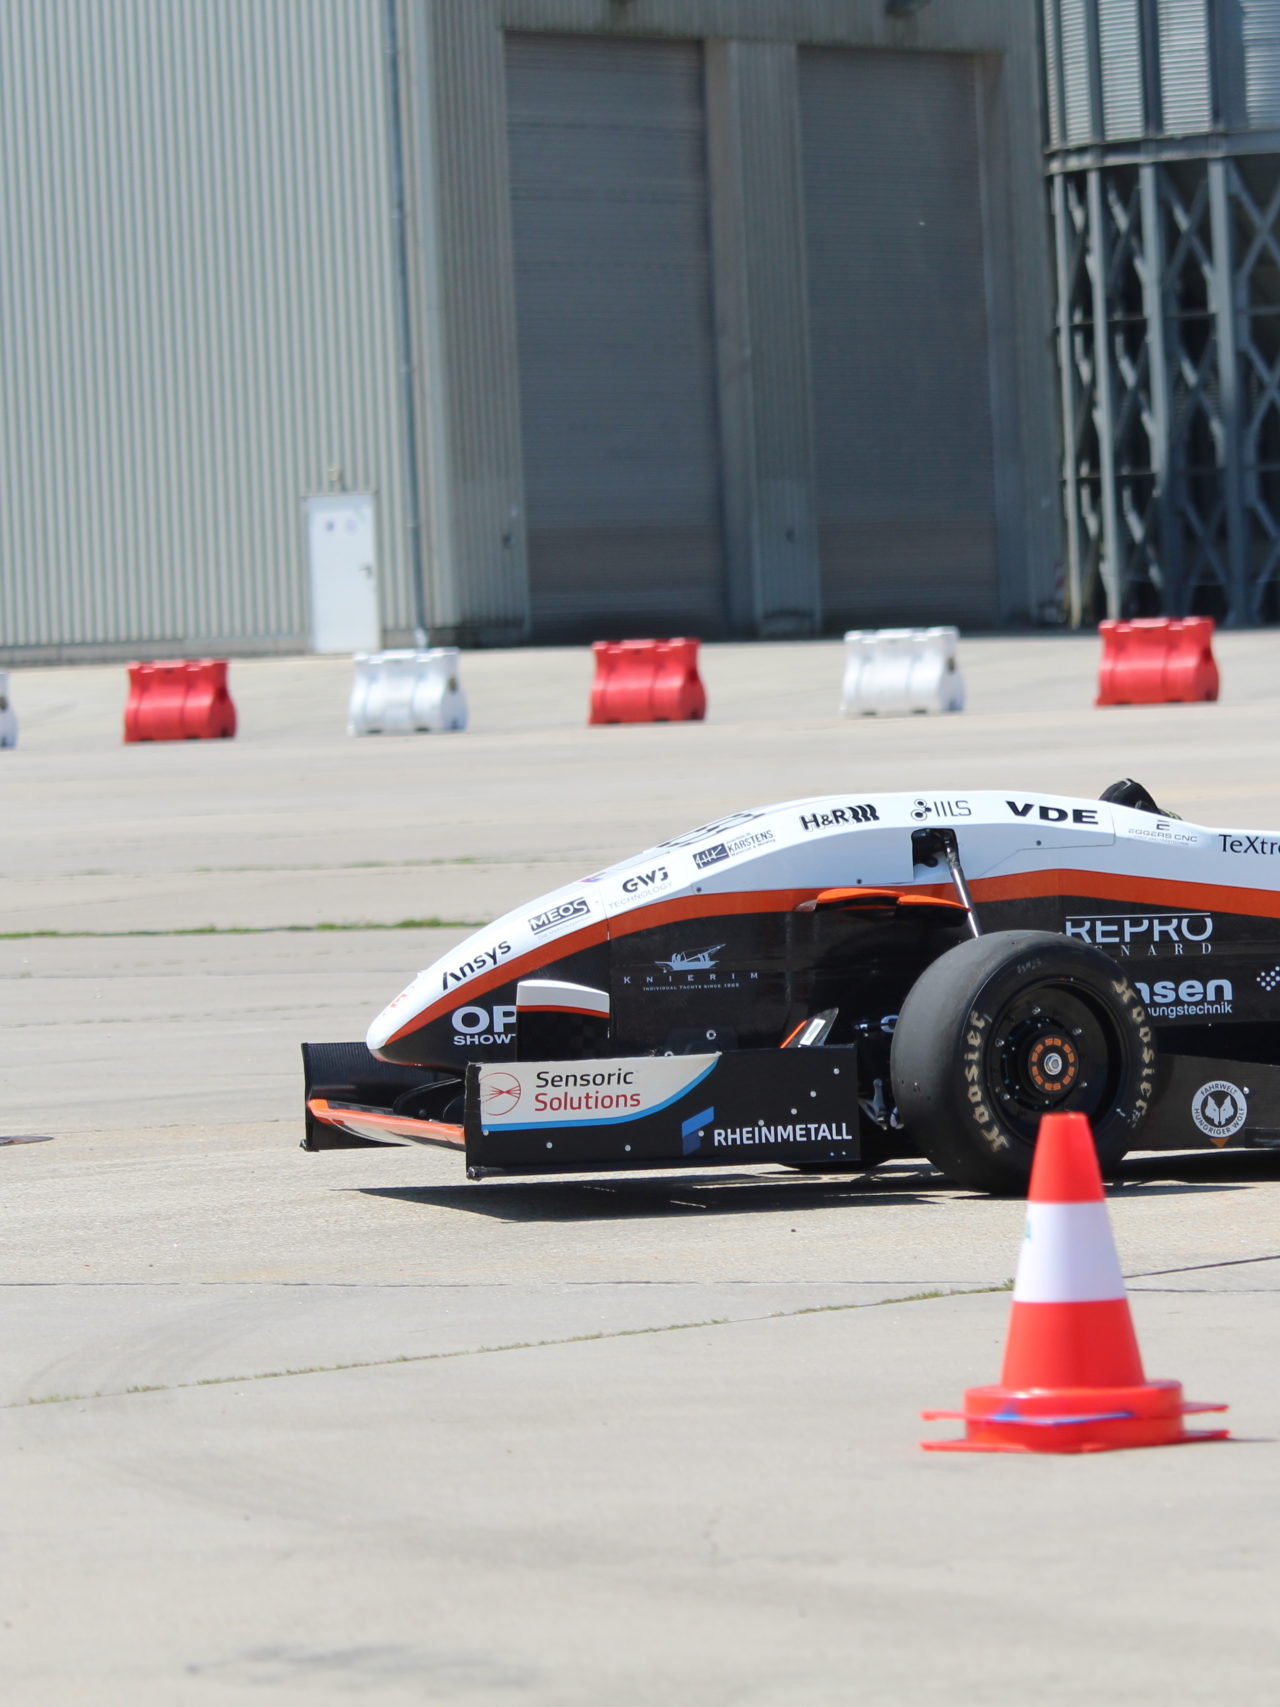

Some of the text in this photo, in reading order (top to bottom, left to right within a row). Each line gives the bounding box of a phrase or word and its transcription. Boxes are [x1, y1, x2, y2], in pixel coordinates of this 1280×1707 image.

[799, 808, 850, 832] H&R
[1007, 801, 1099, 825] VDE
[727, 830, 773, 854] KARSTENS
[1128, 828, 1173, 841] EGGERS
[1174, 833, 1198, 844] CNC
[622, 867, 669, 894] GWJ
[608, 881, 672, 910] TECHNOLOGY
[529, 899, 590, 932] MEOS
[1065, 917, 1214, 944] REPRO
[442, 940, 512, 991] Ansys
[623, 972, 758, 984] KNIERIM
[1148, 1002, 1233, 1019] ungstechnik
[1111, 976, 1155, 1116] Hoosier
[535, 1069, 635, 1089] Sensoric
[964, 1010, 1010, 1152] Hoosier
[1200, 1083, 1238, 1096] FAHRWELT
[534, 1088, 641, 1112] Solutions
[1194, 1108, 1245, 1136] HUNGRIGER WOLF
[713, 1122, 852, 1148] RHEINMETALL
